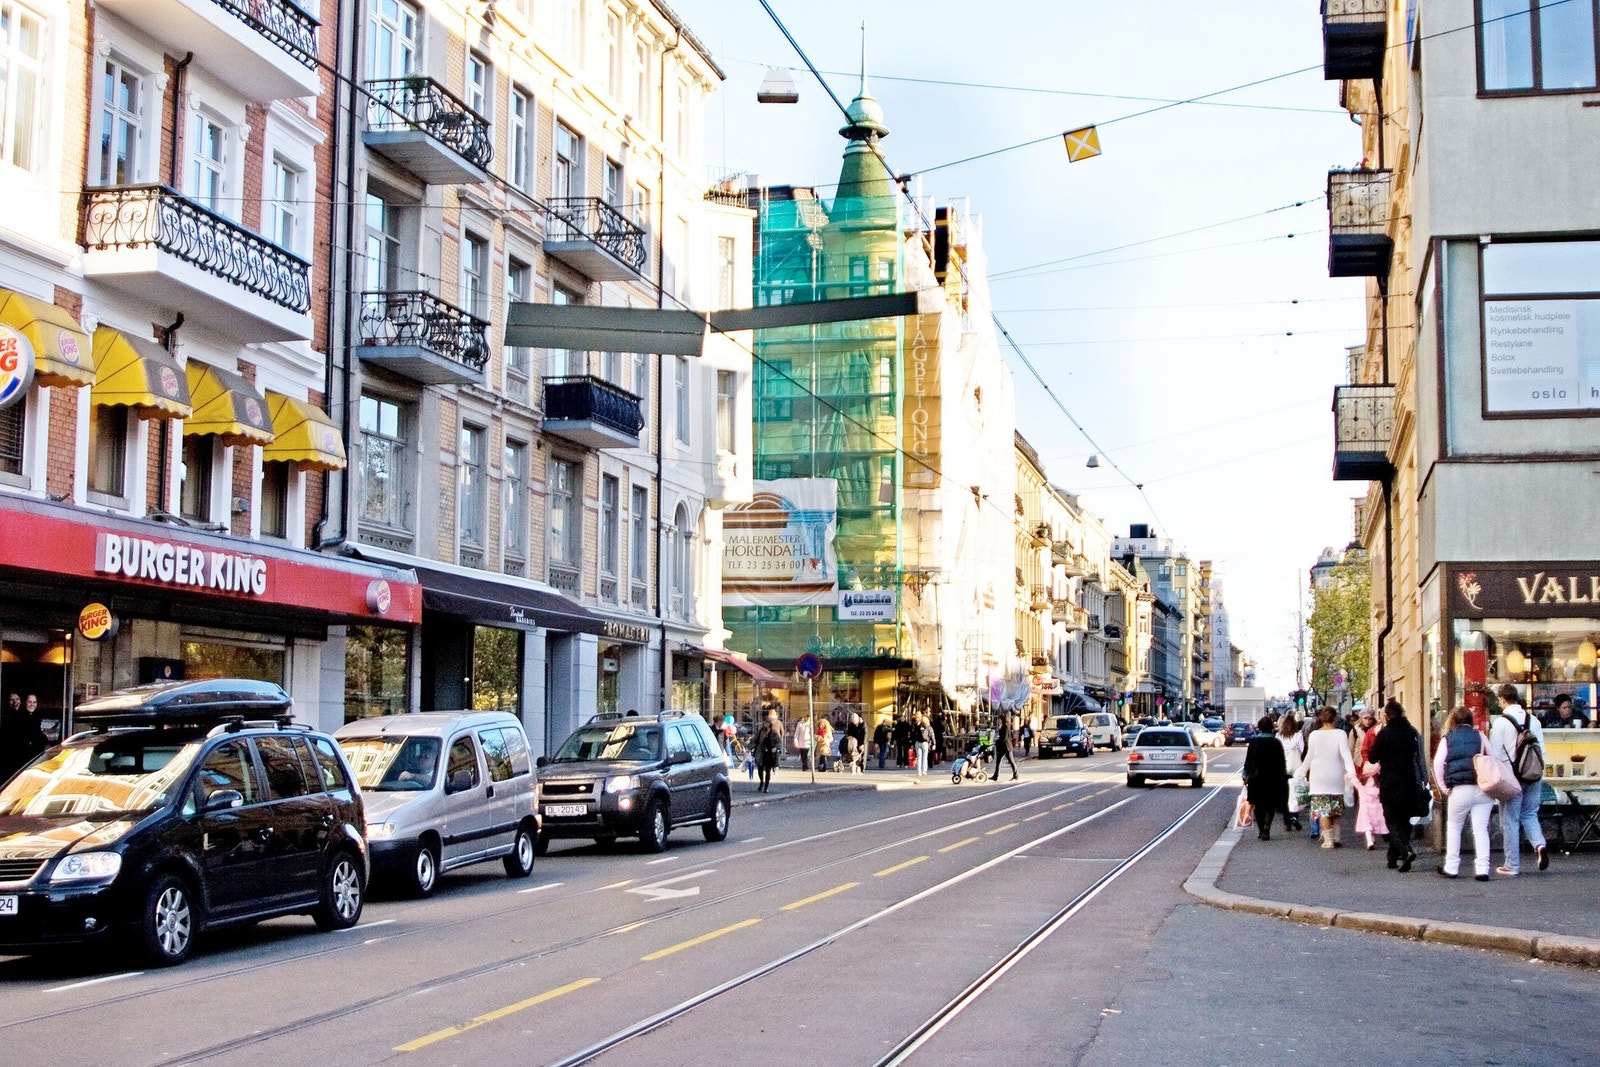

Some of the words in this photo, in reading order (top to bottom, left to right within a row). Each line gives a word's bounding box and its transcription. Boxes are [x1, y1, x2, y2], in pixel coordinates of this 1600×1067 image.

[1489, 305, 1532, 313] Medisinsk
[1490, 313, 1533, 321] kosmetisk
[1534, 312, 1571, 321] hudpleie
[1490, 326, 1564, 336] Rynkebehandling
[1490, 340, 1533, 349] Restylane
[1491, 353, 1516, 361] Botox
[1490, 366, 1564, 375] Svettebehandling
[1532, 387, 1567, 399] oslo
[728, 534, 801, 544] MALERMESTER
[105, 533, 205, 586] BURGER
[209, 552, 267, 595] KING
[746, 560, 758, 569] 23
[759, 560, 772, 569] 25
[775, 560, 786, 569] 34
[789, 560, 800, 569] 00
[80, 609, 108, 623] BURGER
[82, 616, 108, 634] KING
[560, 805, 585, 813] 20143
